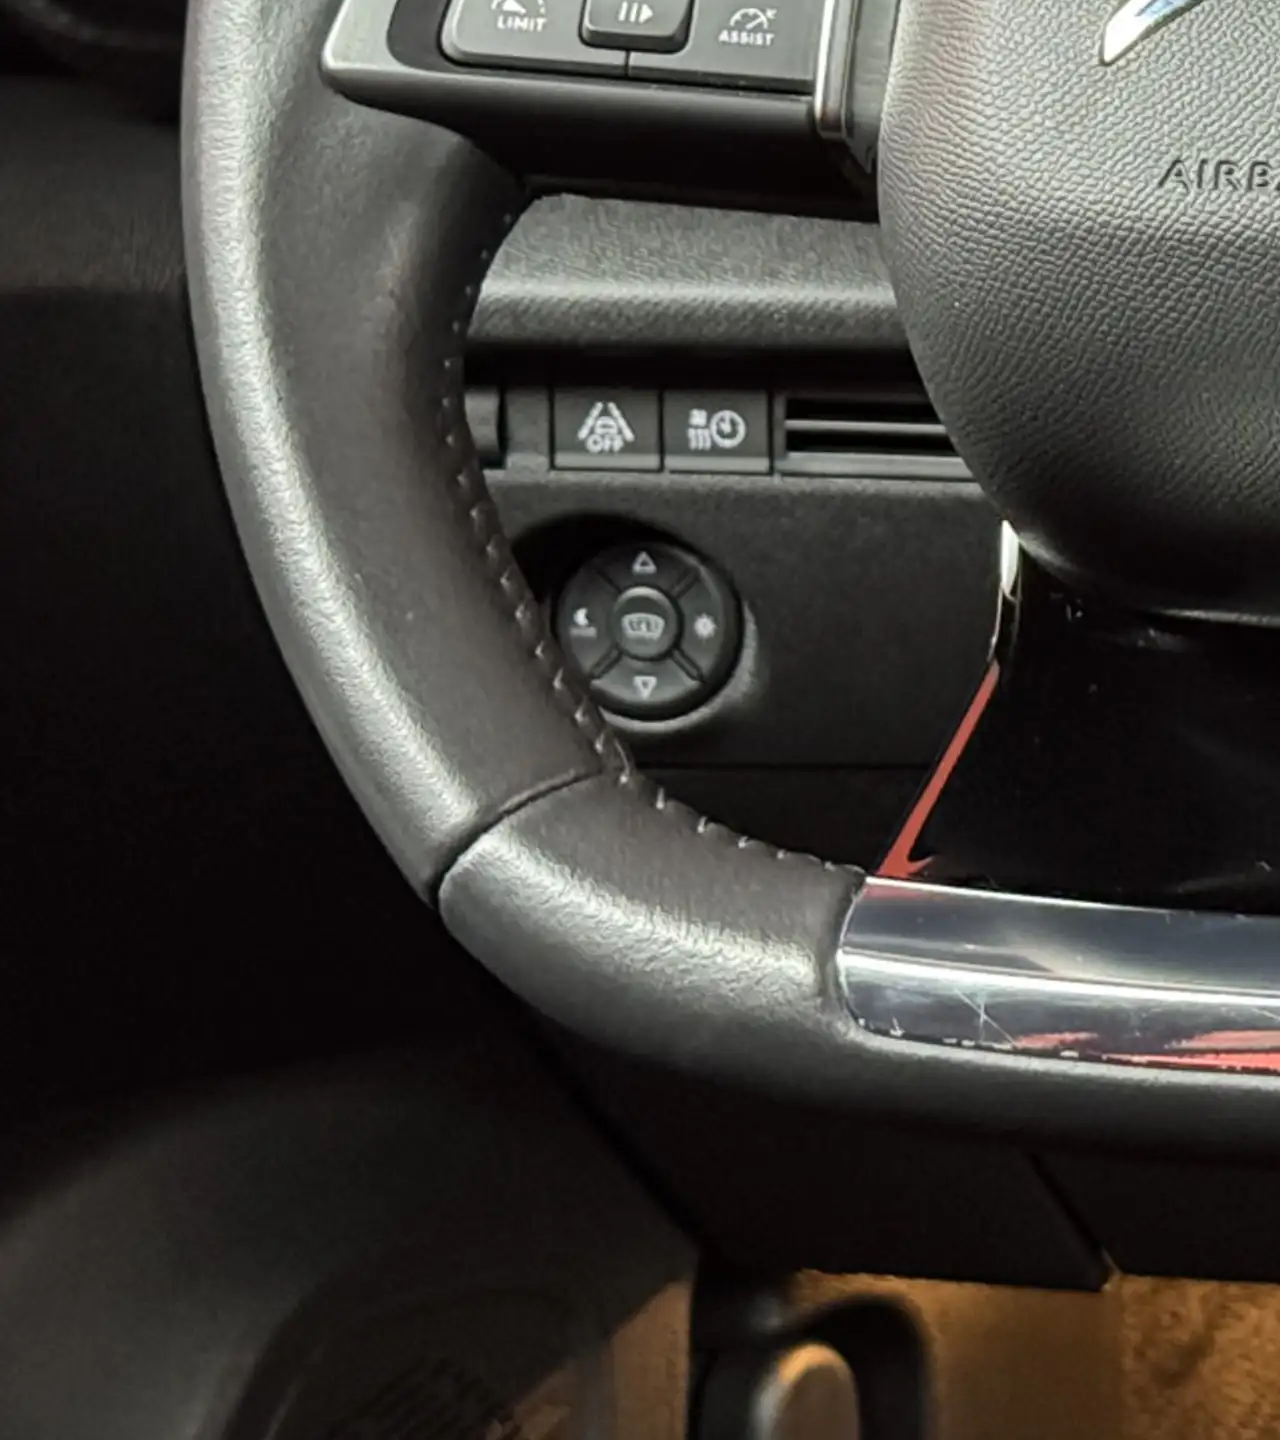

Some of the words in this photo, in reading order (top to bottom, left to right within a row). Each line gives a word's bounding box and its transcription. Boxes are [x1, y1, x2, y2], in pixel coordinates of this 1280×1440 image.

[496, 14, 548, 33] LIMIT
[717, 28, 776, 47] ASSIST
[585, 433, 625, 453] OFF
